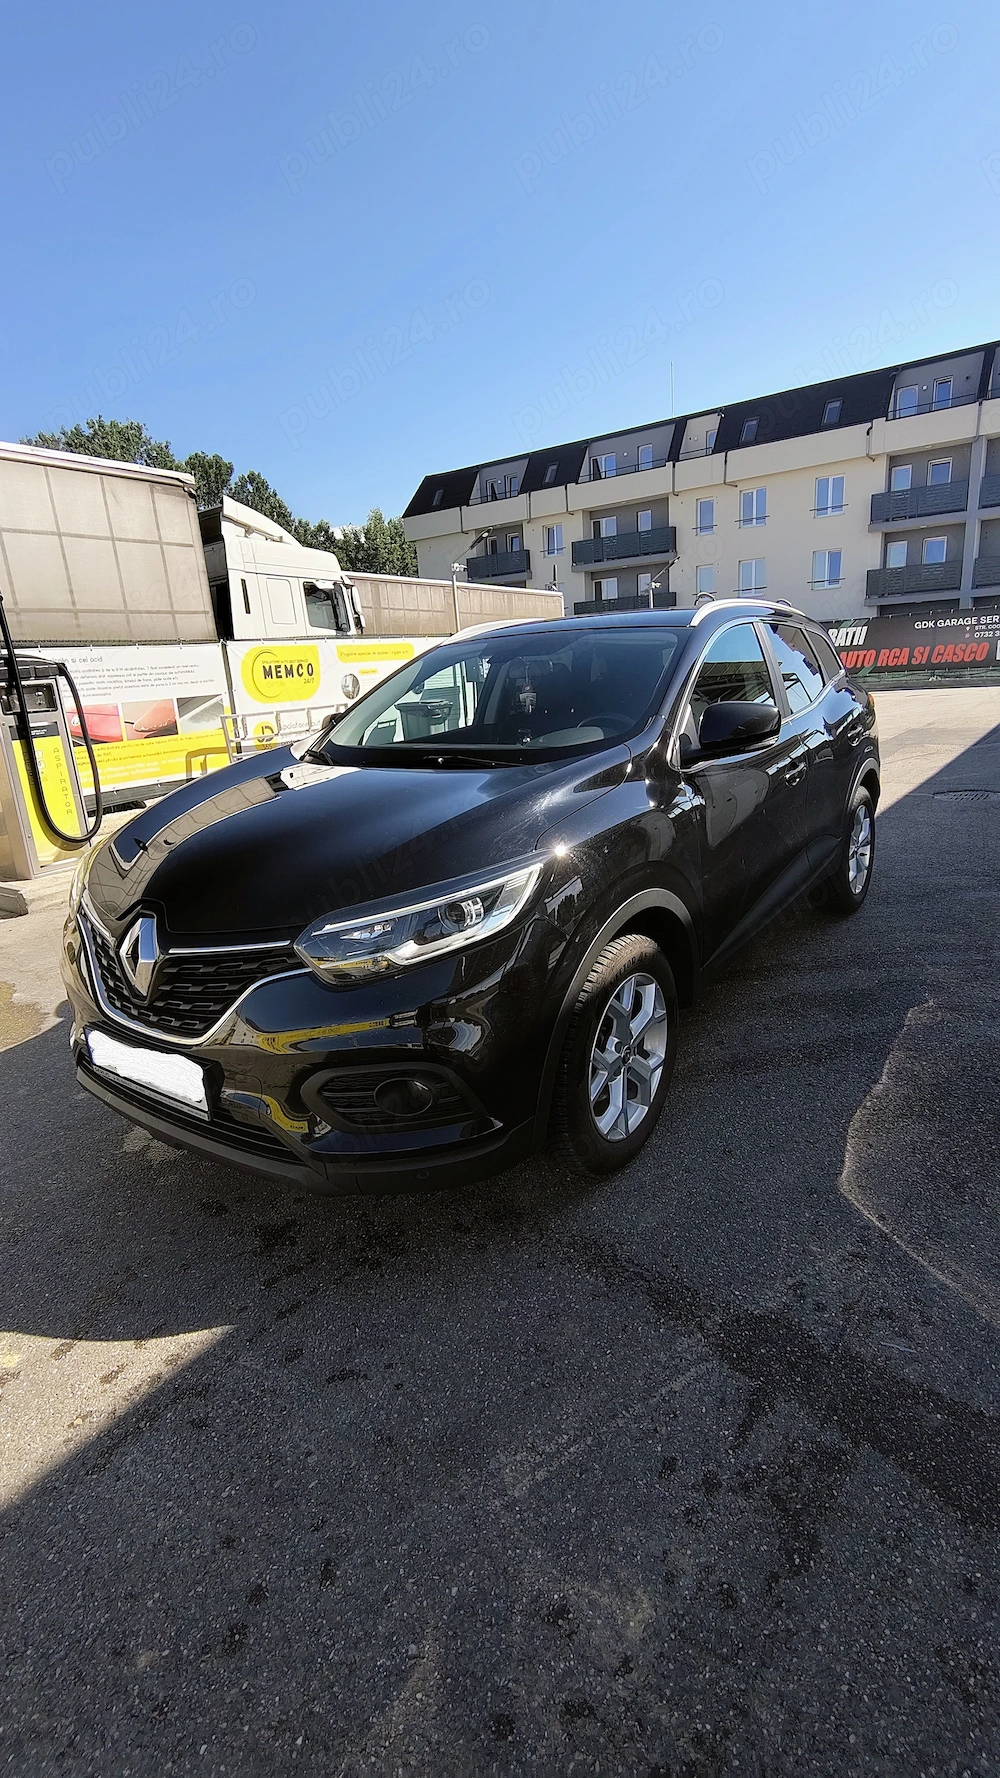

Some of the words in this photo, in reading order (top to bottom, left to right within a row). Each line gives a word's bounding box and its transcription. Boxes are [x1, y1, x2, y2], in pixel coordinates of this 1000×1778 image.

[914, 620, 935, 629] GDK
[937, 616, 978, 627] GARAGE
[980, 615, 1000, 625] SER
[974, 631, 993, 639] 0732
[840, 649, 877, 669] AUTO
[877, 647, 910, 667] RCA
[911, 645, 931, 665] SI
[931, 641, 990, 664] CASCO
[262, 662, 314, 680] MEMCO
[53, 747, 73, 815] ASPIRATOR
